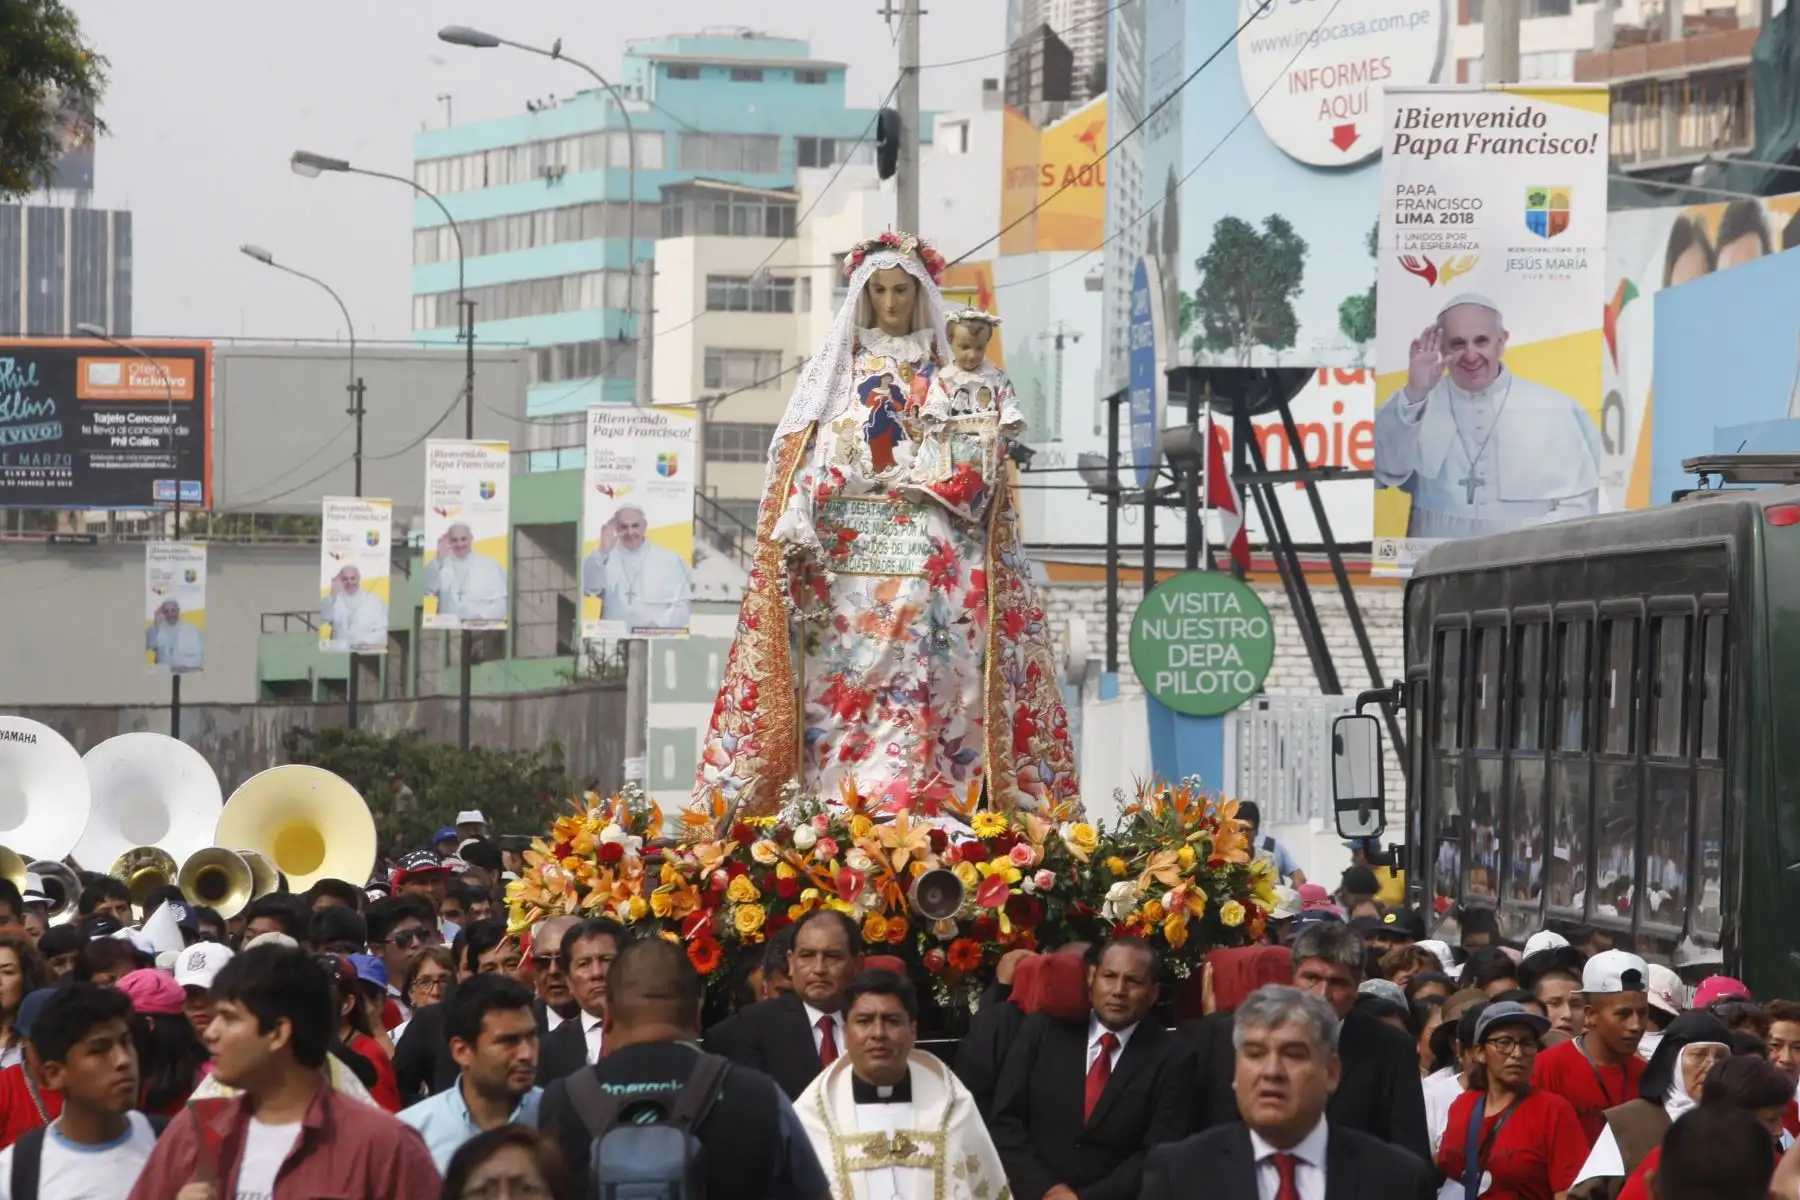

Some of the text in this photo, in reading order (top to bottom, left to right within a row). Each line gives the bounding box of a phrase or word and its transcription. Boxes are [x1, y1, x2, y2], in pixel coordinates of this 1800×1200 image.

[1250, 10, 1430, 53] www.ingocasa.com.pe
[1288, 57, 1392, 95] INFORMES
[1318, 88, 1369, 120] AQUÍ
[1393, 106, 1547, 129] ¡Bienvenido
[1392, 132, 1599, 160] Papa Francisco!
[1396, 184, 1436, 196] PAPA
[1395, 198, 1483, 211] FRANCISCO
[1395, 212, 1475, 224] LIMA 2018
[1404, 232, 1467, 241] UNIDOS POR
[1404, 241, 1480, 250] LA ESPERANZA
[1160, 592, 1242, 614] VISITA
[1141, 617, 1269, 640] NUESTRO
[1168, 644, 1243, 668] DEPA
[1155, 670, 1256, 695] PILOTO
[0, 730, 37, 744] YAMAHA
